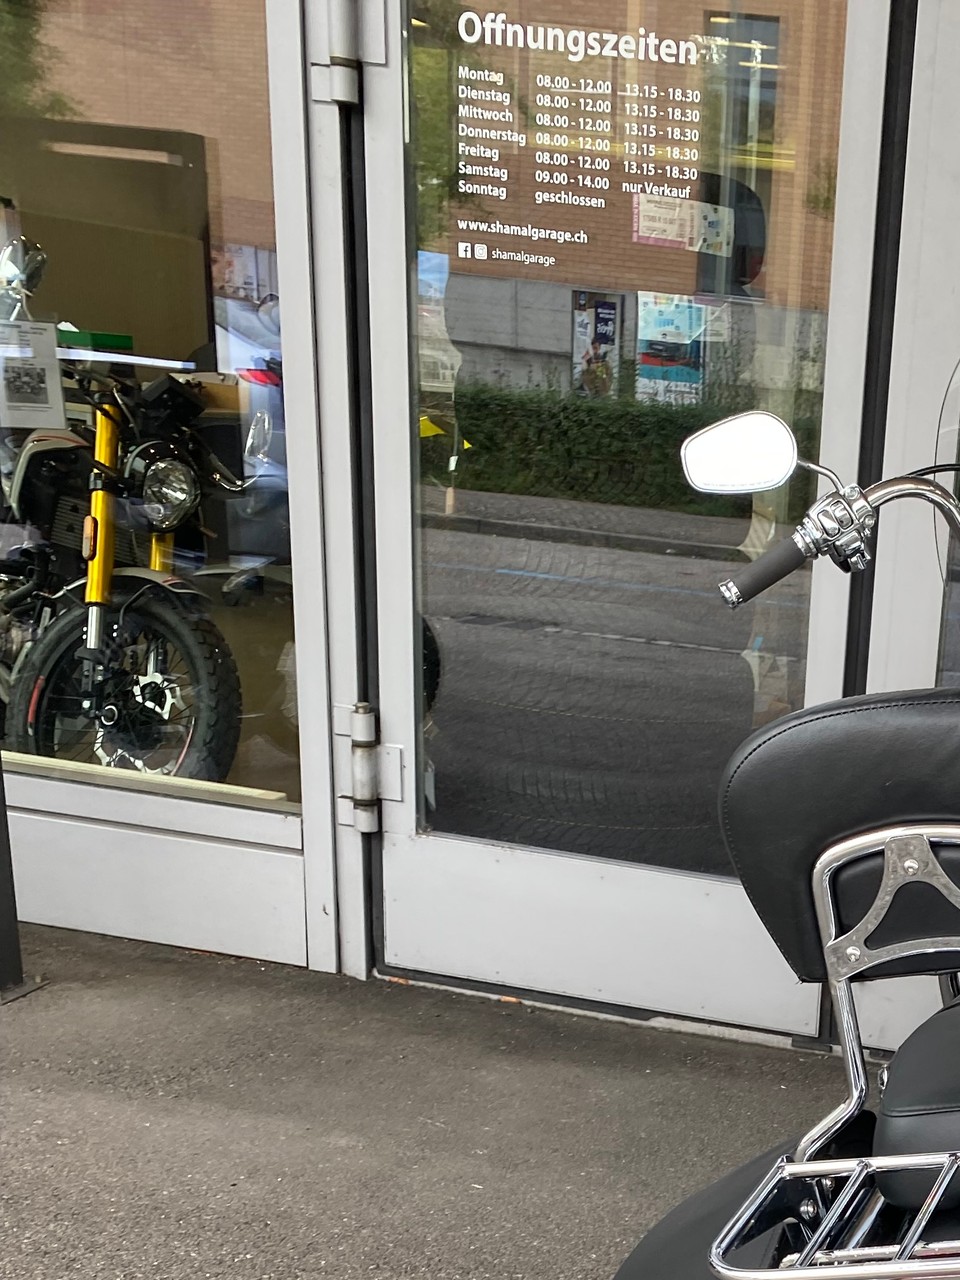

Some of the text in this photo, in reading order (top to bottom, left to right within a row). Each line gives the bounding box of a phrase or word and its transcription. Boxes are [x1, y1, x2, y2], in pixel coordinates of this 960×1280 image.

[458, 66, 504, 85] Montag
[537, 75, 569, 90] 08.00
[579, 79, 611, 94] 12.00
[625, 84, 658, 98] 13.15
[668, 88, 700, 103] 18.30
[458, 86, 510, 104] Dienstag
[537, 94, 569, 109] 08.00
[579, 98, 611, 113] 12.00
[625, 103, 657, 118] 13.15
[668, 107, 700, 122] 18.30
[458, 105, 512, 122] Mittwoch
[536, 114, 568, 128] 08.00
[579, 118, 610, 132] 12.00
[624, 123, 656, 138] 13.15
[667, 127, 699, 142] 18.30
[458, 124, 526, 146] Donnerstag
[536, 132, 568, 147] 08.00
[578, 137, 610, 152] 12.00
[624, 142, 656, 157] 13.15
[666, 146, 698, 161] 18.30
[458, 144, 499, 161] Freitag
[536, 152, 568, 166] 08.00
[578, 156, 609, 171] 12.00
[624, 161, 655, 176] 13.15
[666, 166, 698, 180] 18.30
[458, 162, 508, 180] Samstag
[535, 171, 567, 185] 09.00
[577, 175, 609, 189] 14.00
[622, 182, 642, 194] nur
[645, 183, 691, 199] Verkauf
[458, 182, 605, 208] Sonntag geschlossen
[458, 218, 588, 244] www.shamalgarage.ch
[492, 248, 555, 266] shamalgarage
